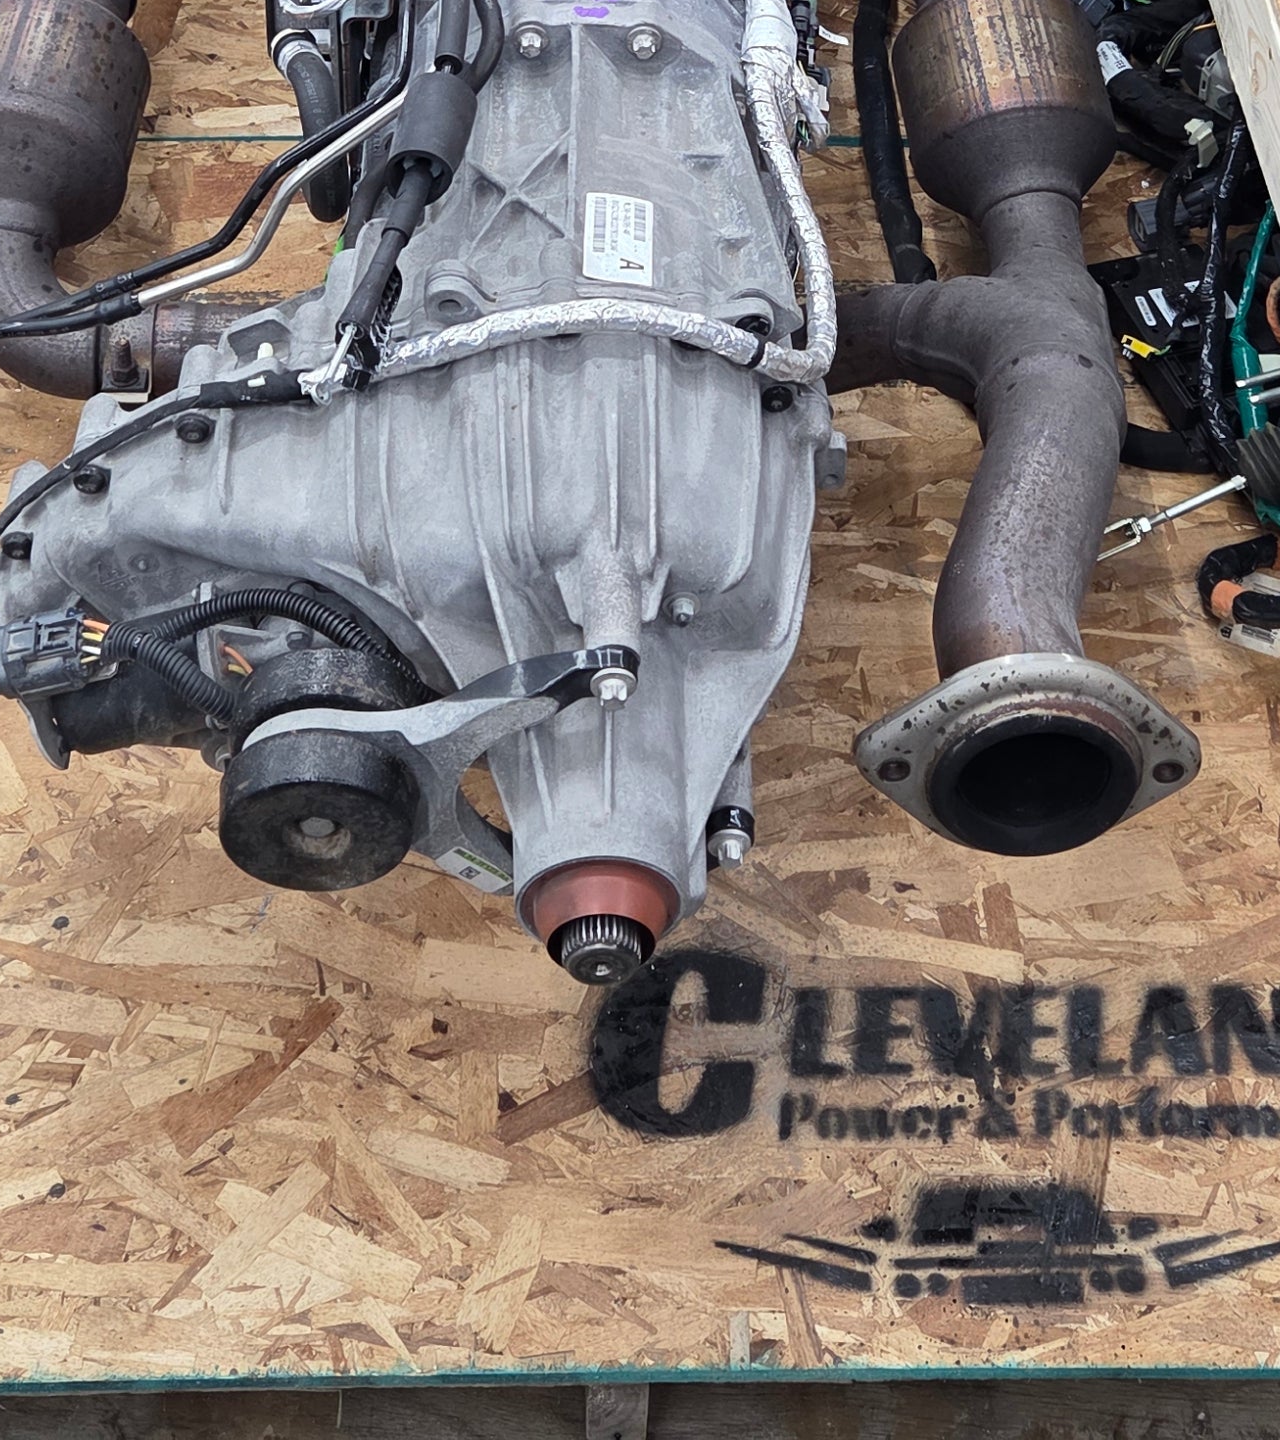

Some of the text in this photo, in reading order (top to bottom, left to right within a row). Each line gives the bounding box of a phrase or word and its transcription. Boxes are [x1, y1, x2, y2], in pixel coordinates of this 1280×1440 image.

[619, 257, 645, 271] A
[778, 1091, 967, 1144] Power
[974, 1094, 1020, 1140] &
